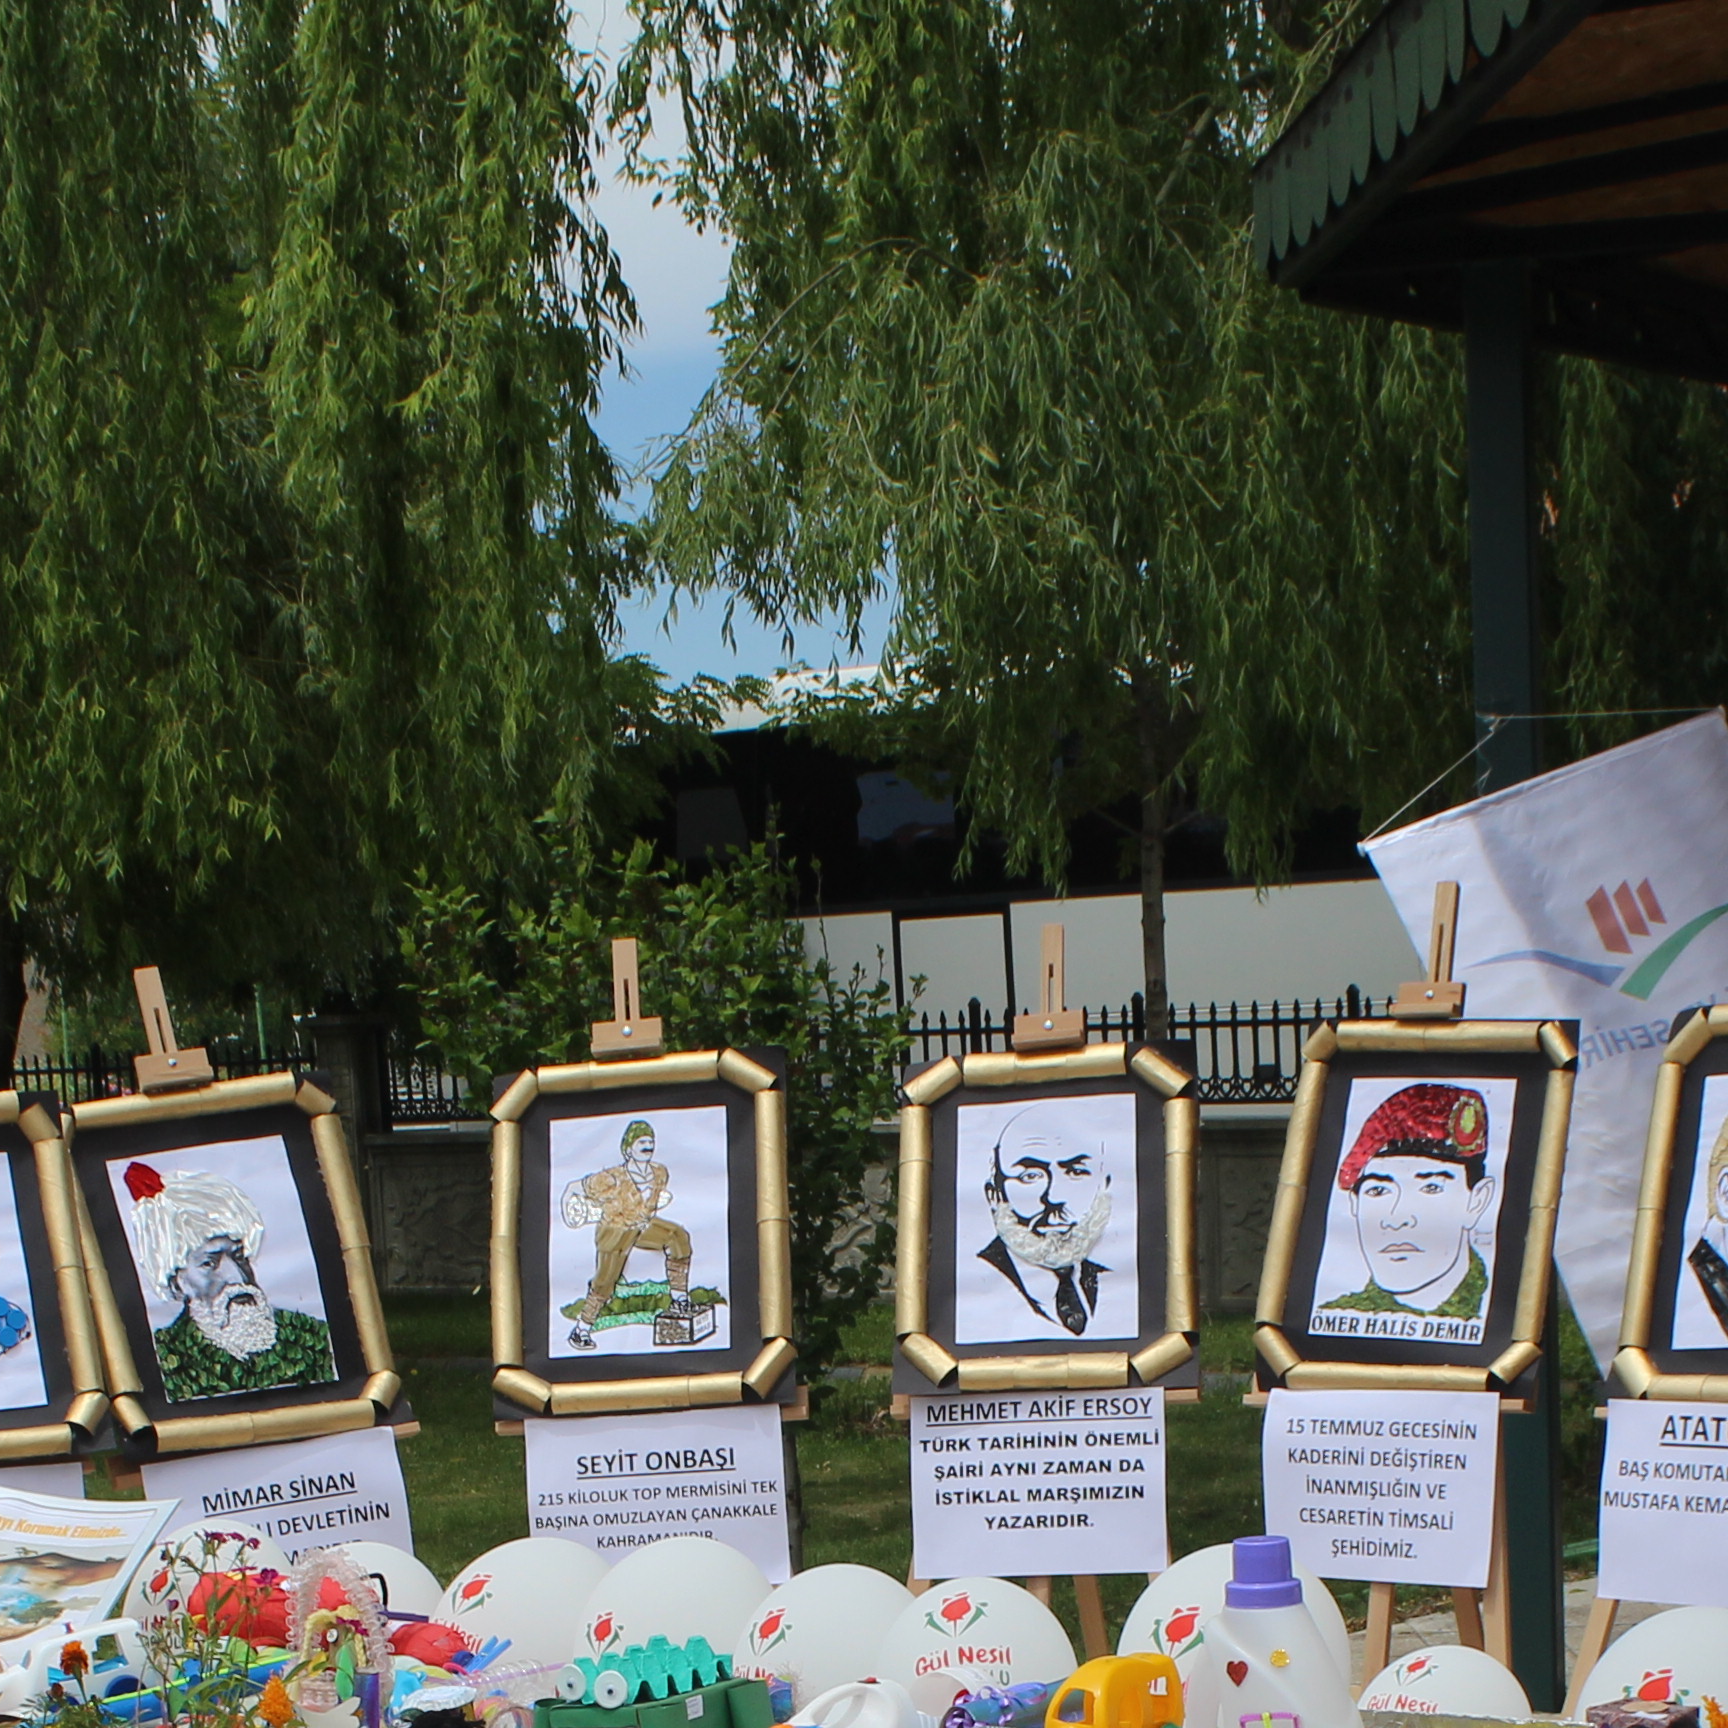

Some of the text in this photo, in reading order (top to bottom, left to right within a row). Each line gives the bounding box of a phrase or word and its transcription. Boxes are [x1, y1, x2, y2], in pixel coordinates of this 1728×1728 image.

[1311, 1309, 1360, 1333] ÖMER
[926, 1395, 1153, 1423] MEHMET AKİF ERSOY
[920, 1428, 1159, 1453] TÜRK TARİHİNİN ÖNEMLİ
[1286, 1418, 1477, 1440] 15 TEMMUZ GECESİNİN
[576, 1447, 735, 1475] SEYİT ONBAŞI
[934, 1458, 1145, 1483] ŞAİRİ AYNI ZAMAN DA
[1288, 1447, 1467, 1471] KADERİNİ DEĞİŞTİREN
[1618, 1460, 1649, 1482] BAŞ
[202, 1471, 357, 1513] MİMAR SİNAN
[538, 1479, 777, 1506] 215 KİLOLUK TOP MERMİSİNİ TEK
[935, 1485, 1145, 1505] İSTİKLAL MARŞIMIZIN
[1306, 1474, 1447, 1501] İNANMIŞLIĞIN VE
[1604, 1491, 1680, 1512] MUSTAFA
[277, 1500, 390, 1536] DEVLETİNİN
[535, 1503, 778, 1531] BAŞINA OMUZLAYAN ÇANAKKALE
[984, 1514, 1094, 1530] YAZARIDIR.
[1299, 1506, 1454, 1530] CESARETİN TİMSALİ
[1331, 1537, 1417, 1559] ŞEHİDİMİZ.
[916, 1645, 1011, 1676] Gül Nesil
